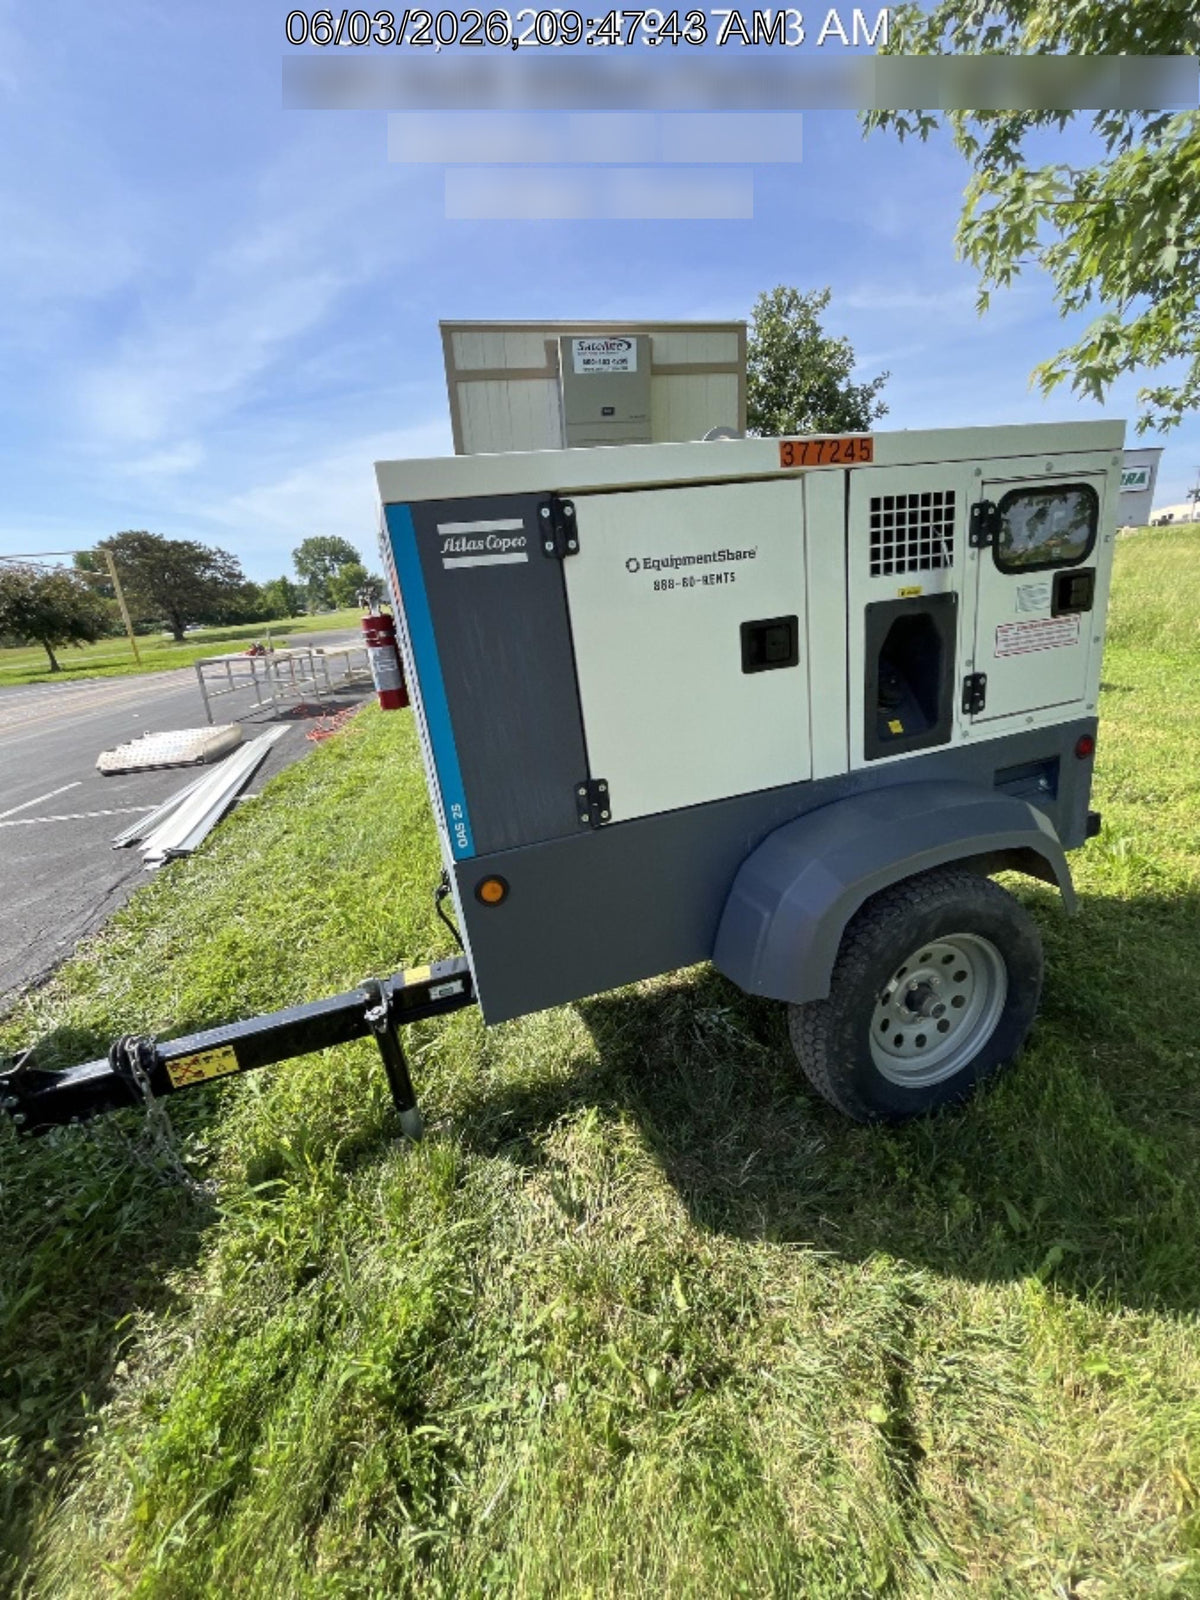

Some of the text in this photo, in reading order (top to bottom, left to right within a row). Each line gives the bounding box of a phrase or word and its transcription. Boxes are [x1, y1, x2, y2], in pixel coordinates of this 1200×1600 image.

[782, 439, 870, 466] 377245
[441, 535, 526, 553] Atlas Copco
[643, 548, 756, 571] EquipmentShare
